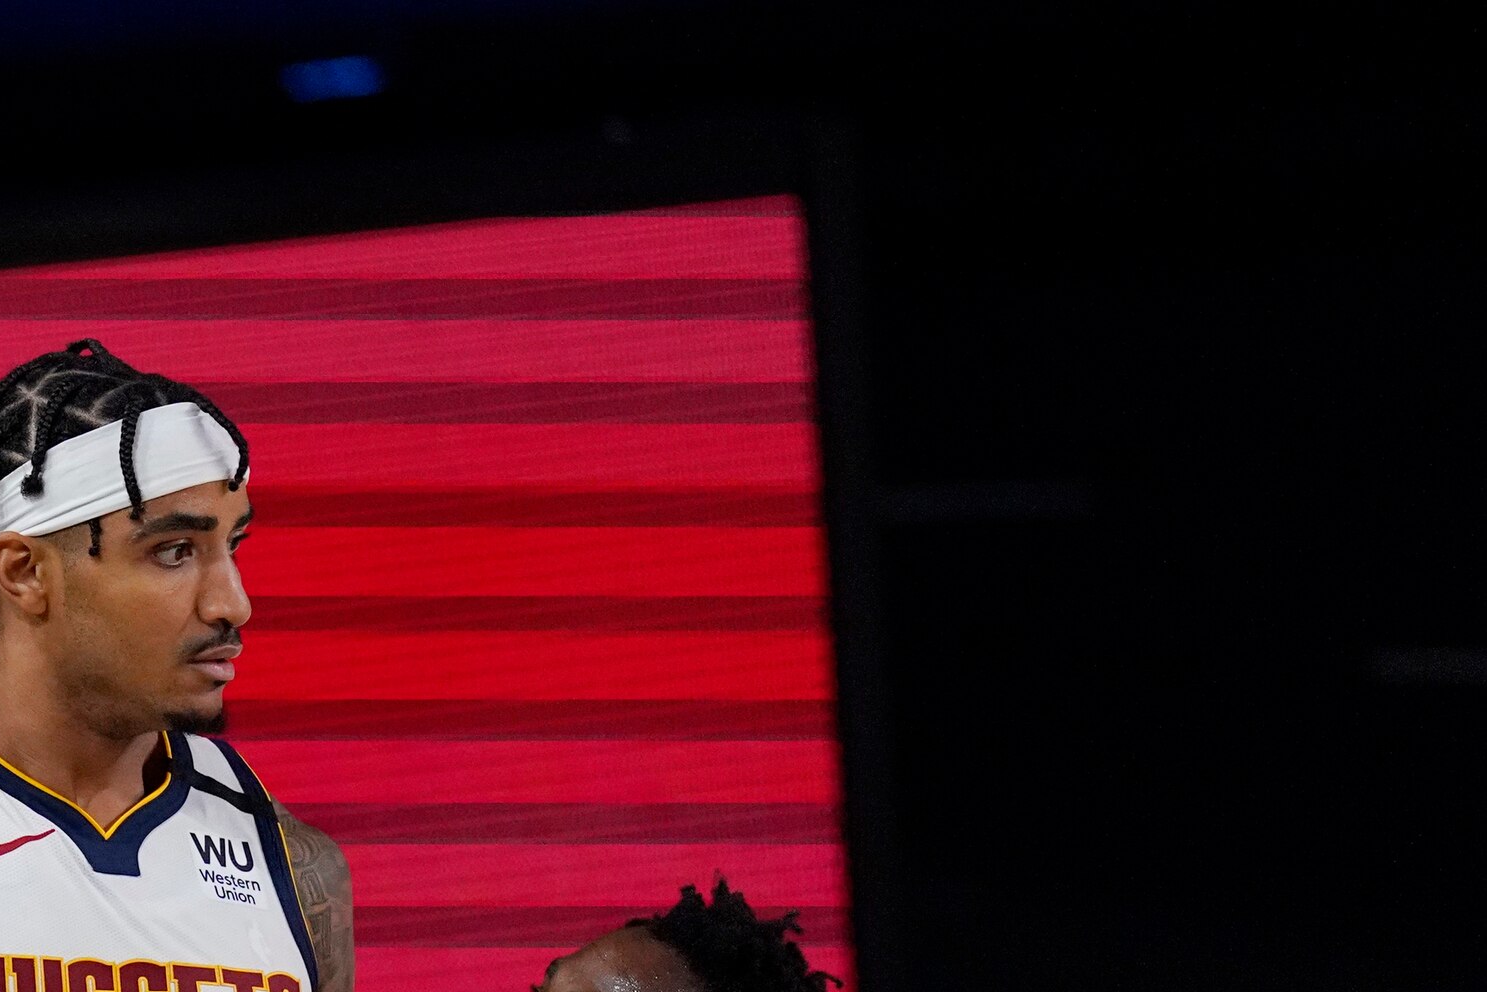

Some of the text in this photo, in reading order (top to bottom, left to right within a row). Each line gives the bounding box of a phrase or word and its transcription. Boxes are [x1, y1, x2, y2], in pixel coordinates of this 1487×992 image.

[190, 832, 254, 872] WU
[199, 869, 261, 891] Western
[214, 885, 256, 904] Union
